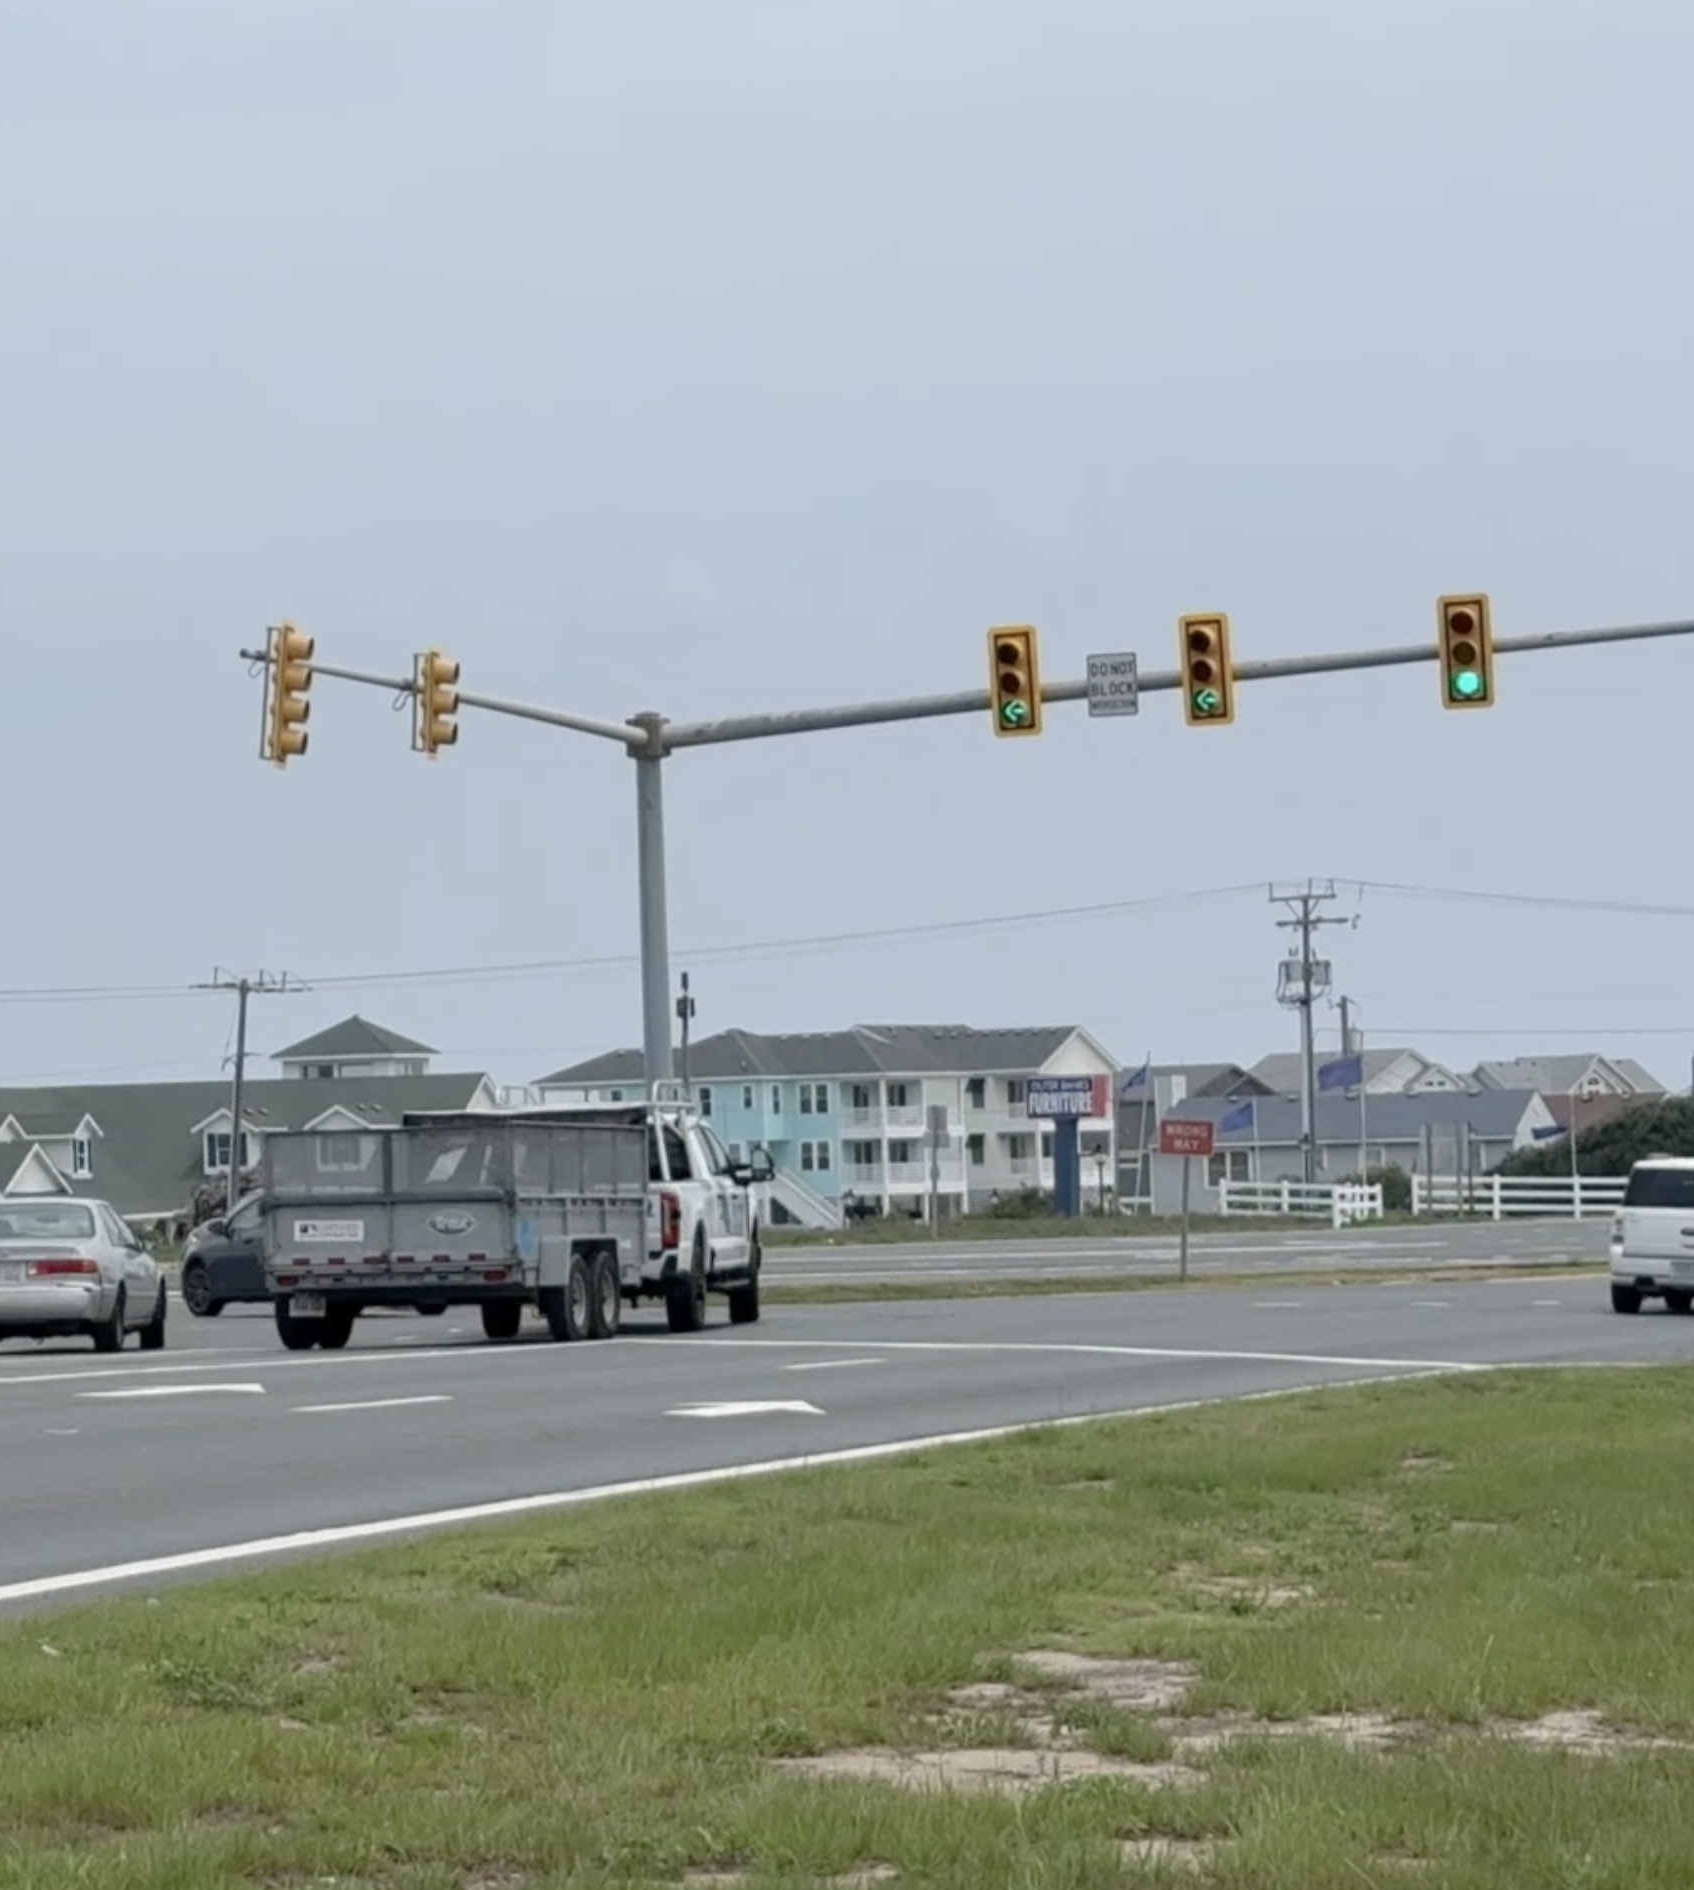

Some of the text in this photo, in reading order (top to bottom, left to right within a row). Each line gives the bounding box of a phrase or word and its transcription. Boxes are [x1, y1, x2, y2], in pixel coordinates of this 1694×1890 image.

[1090, 661, 1133, 677] DO NOT
[1090, 682, 1134, 697] BLOCK
[1029, 1092, 1093, 1115] FURNITURE
[1165, 1124, 1208, 1137] WRONG
[1174, 1139, 1199, 1151] WAY
